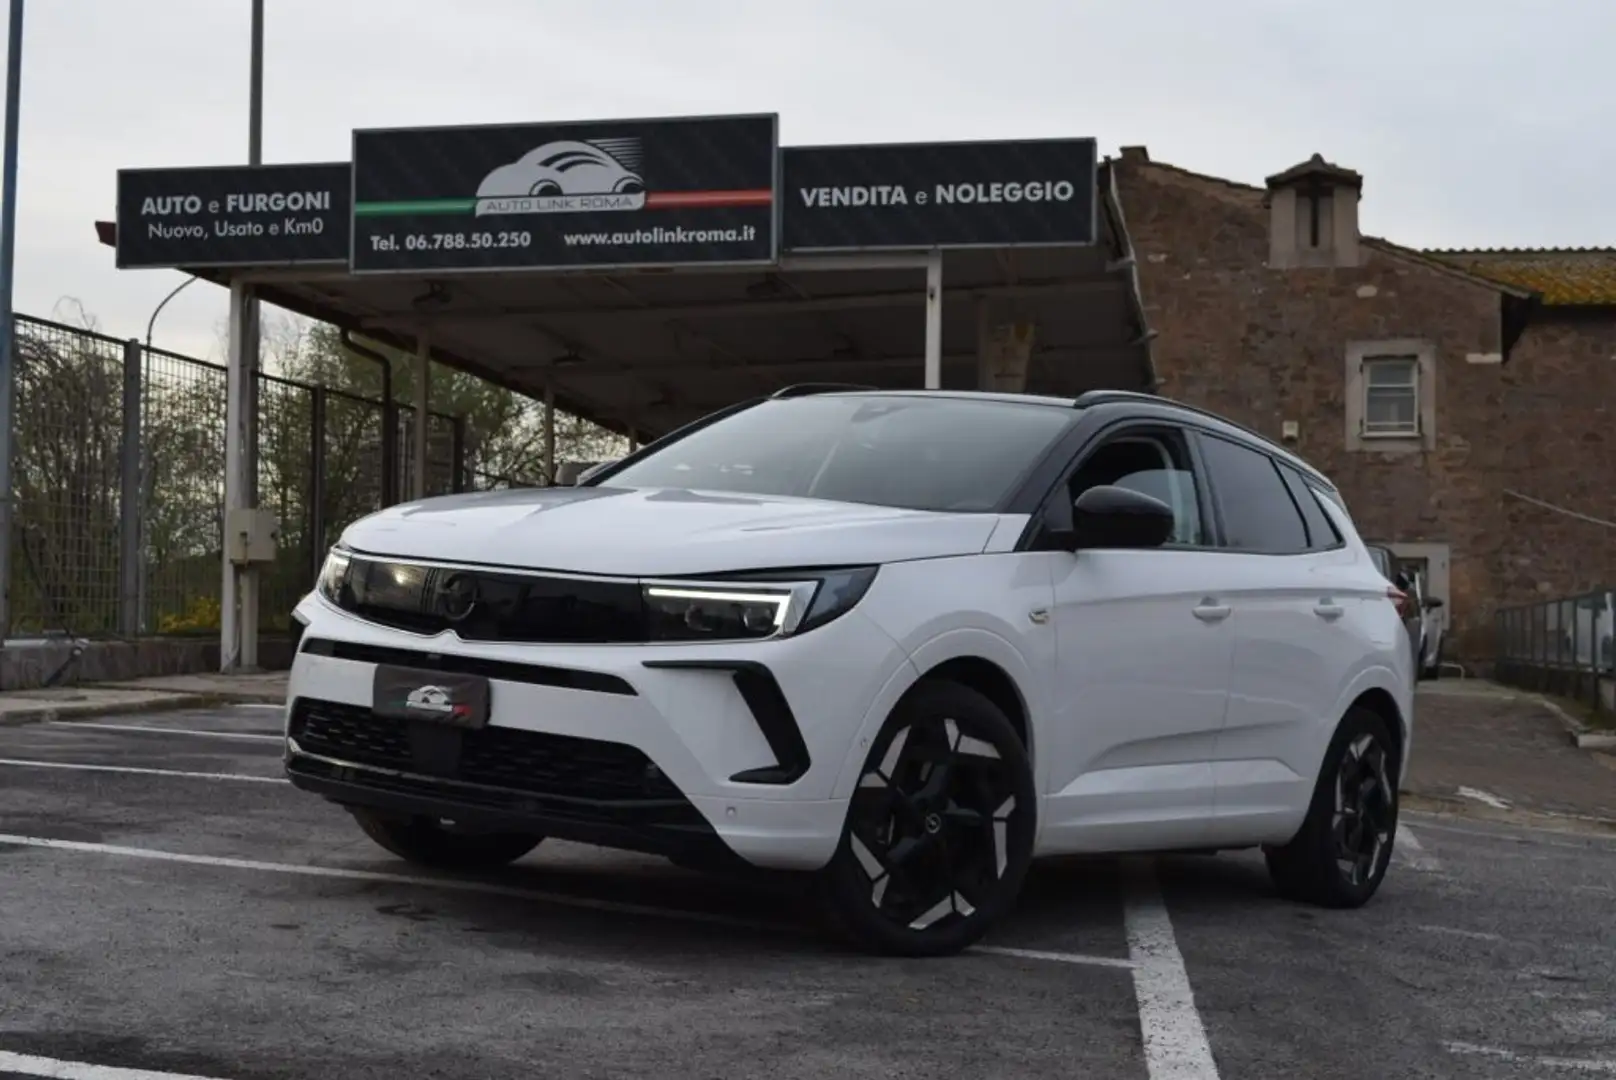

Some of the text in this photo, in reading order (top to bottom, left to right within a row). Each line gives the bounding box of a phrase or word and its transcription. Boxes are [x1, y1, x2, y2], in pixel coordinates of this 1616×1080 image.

[141, 191, 331, 215] AUTO e FURGONI
[800, 180, 1074, 207] VENDITA e NOLEGGIO
[486, 196, 634, 212] AUTO LINK ROMA
[148, 223, 209, 240] Nuovo,
[214, 220, 264, 237] Usato
[268, 223, 280, 235] e
[563, 225, 756, 246] www.autolinkroma.it
[370, 231, 532, 251] Tel. 06.788.50.250
